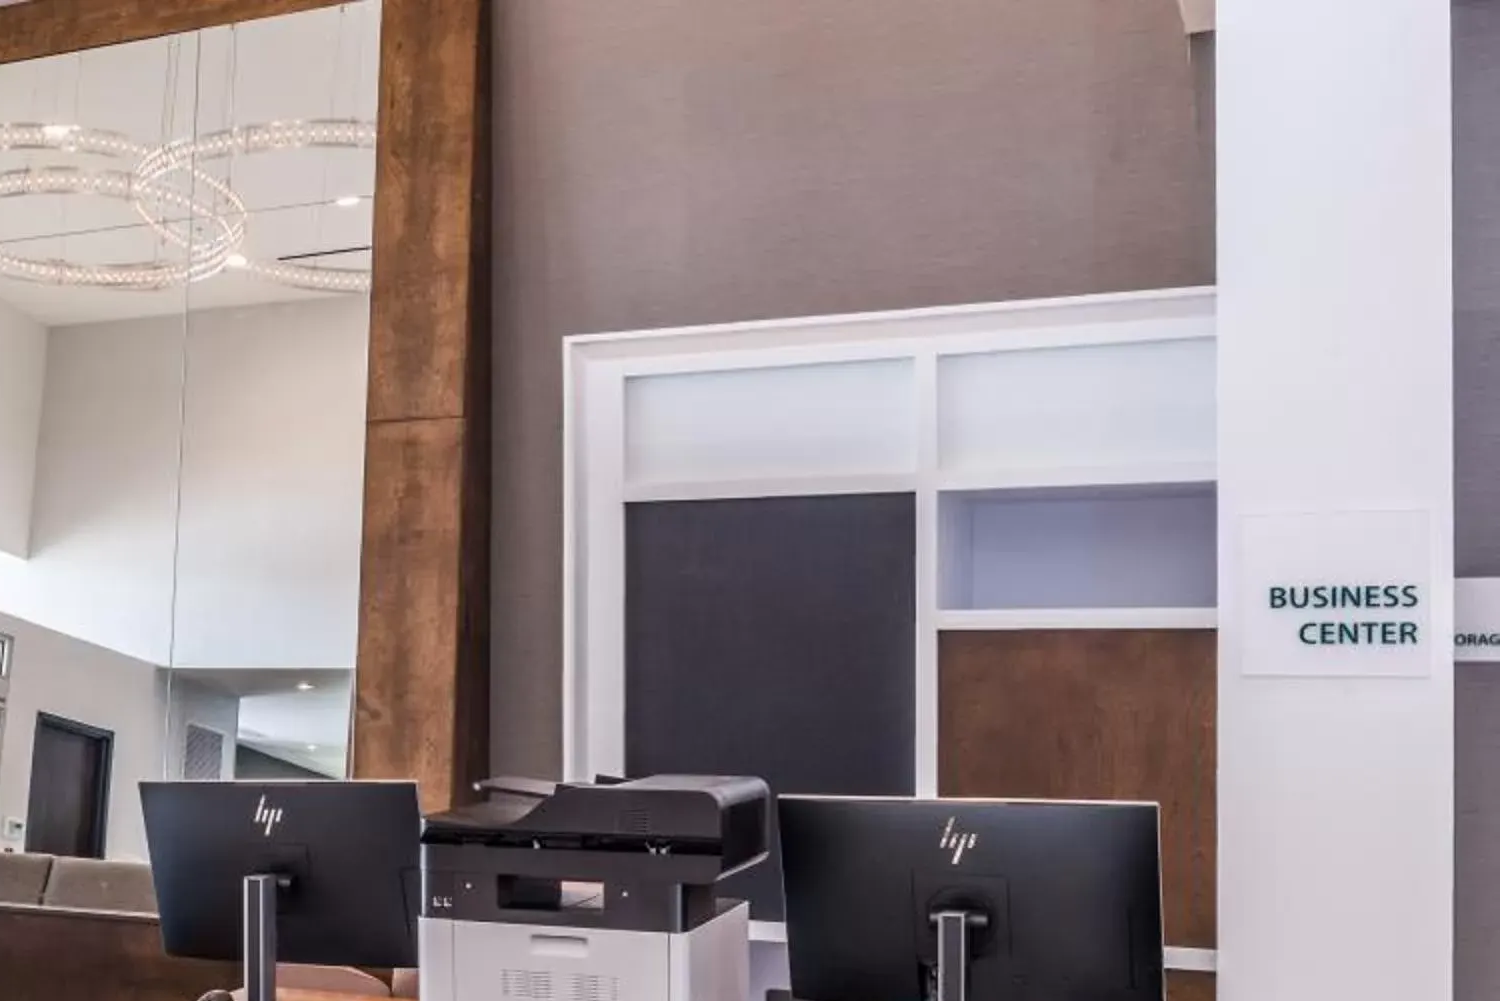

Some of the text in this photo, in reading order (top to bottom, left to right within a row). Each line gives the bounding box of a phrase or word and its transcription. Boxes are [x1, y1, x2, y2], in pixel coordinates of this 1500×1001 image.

[1269, 585, 1419, 609] BUSINESS
[1298, 621, 1419, 645] CENTER
[255, 795, 283, 836] hp
[940, 816, 976, 865] hp
